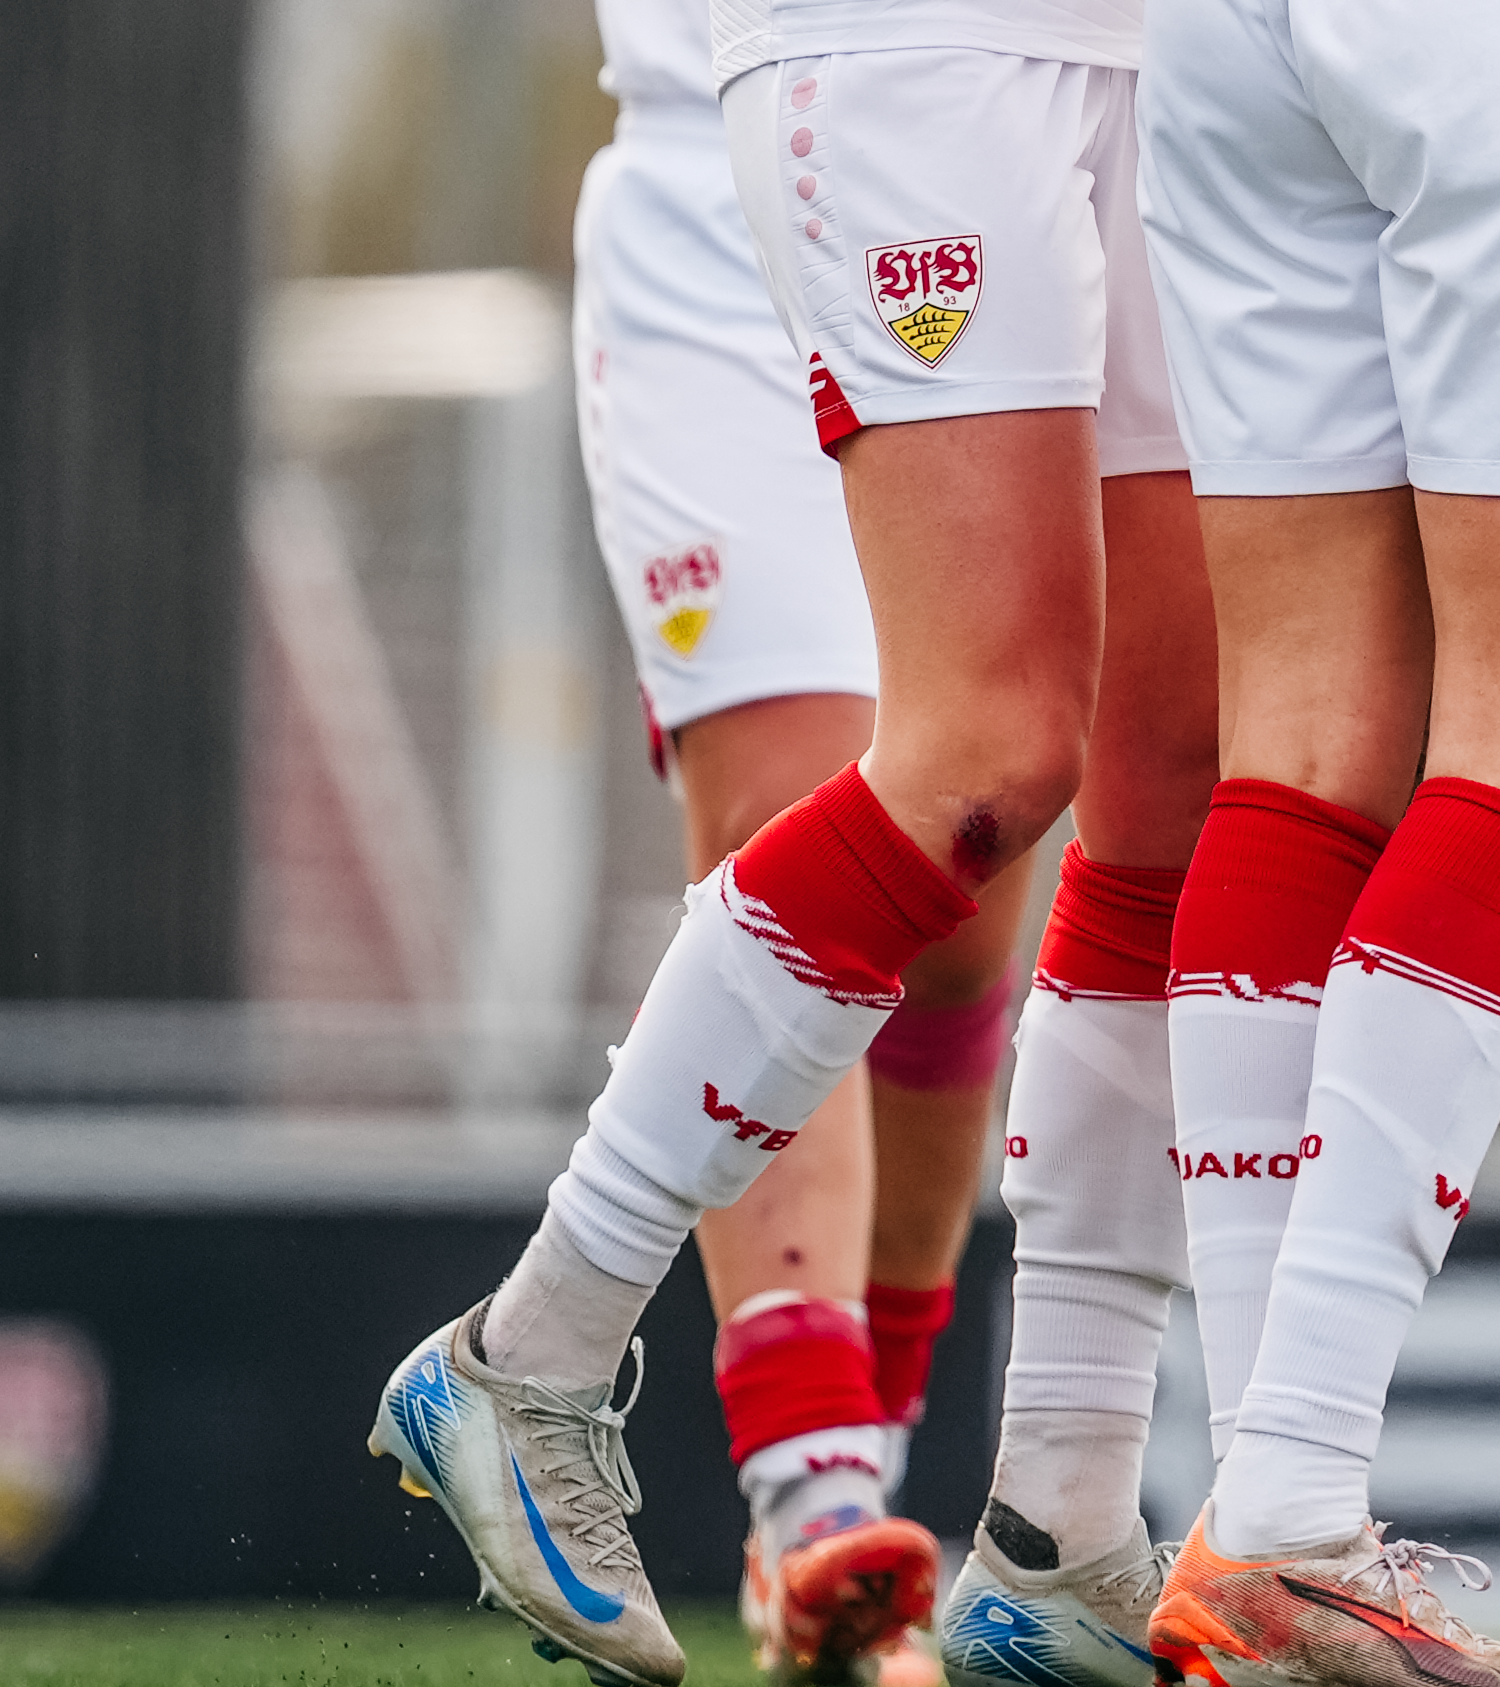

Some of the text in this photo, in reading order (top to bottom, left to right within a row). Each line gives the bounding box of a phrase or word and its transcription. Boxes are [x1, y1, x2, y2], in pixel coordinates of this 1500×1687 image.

[897, 295, 957, 313] 18 93
[1182, 1151, 1301, 1181] JAKO
